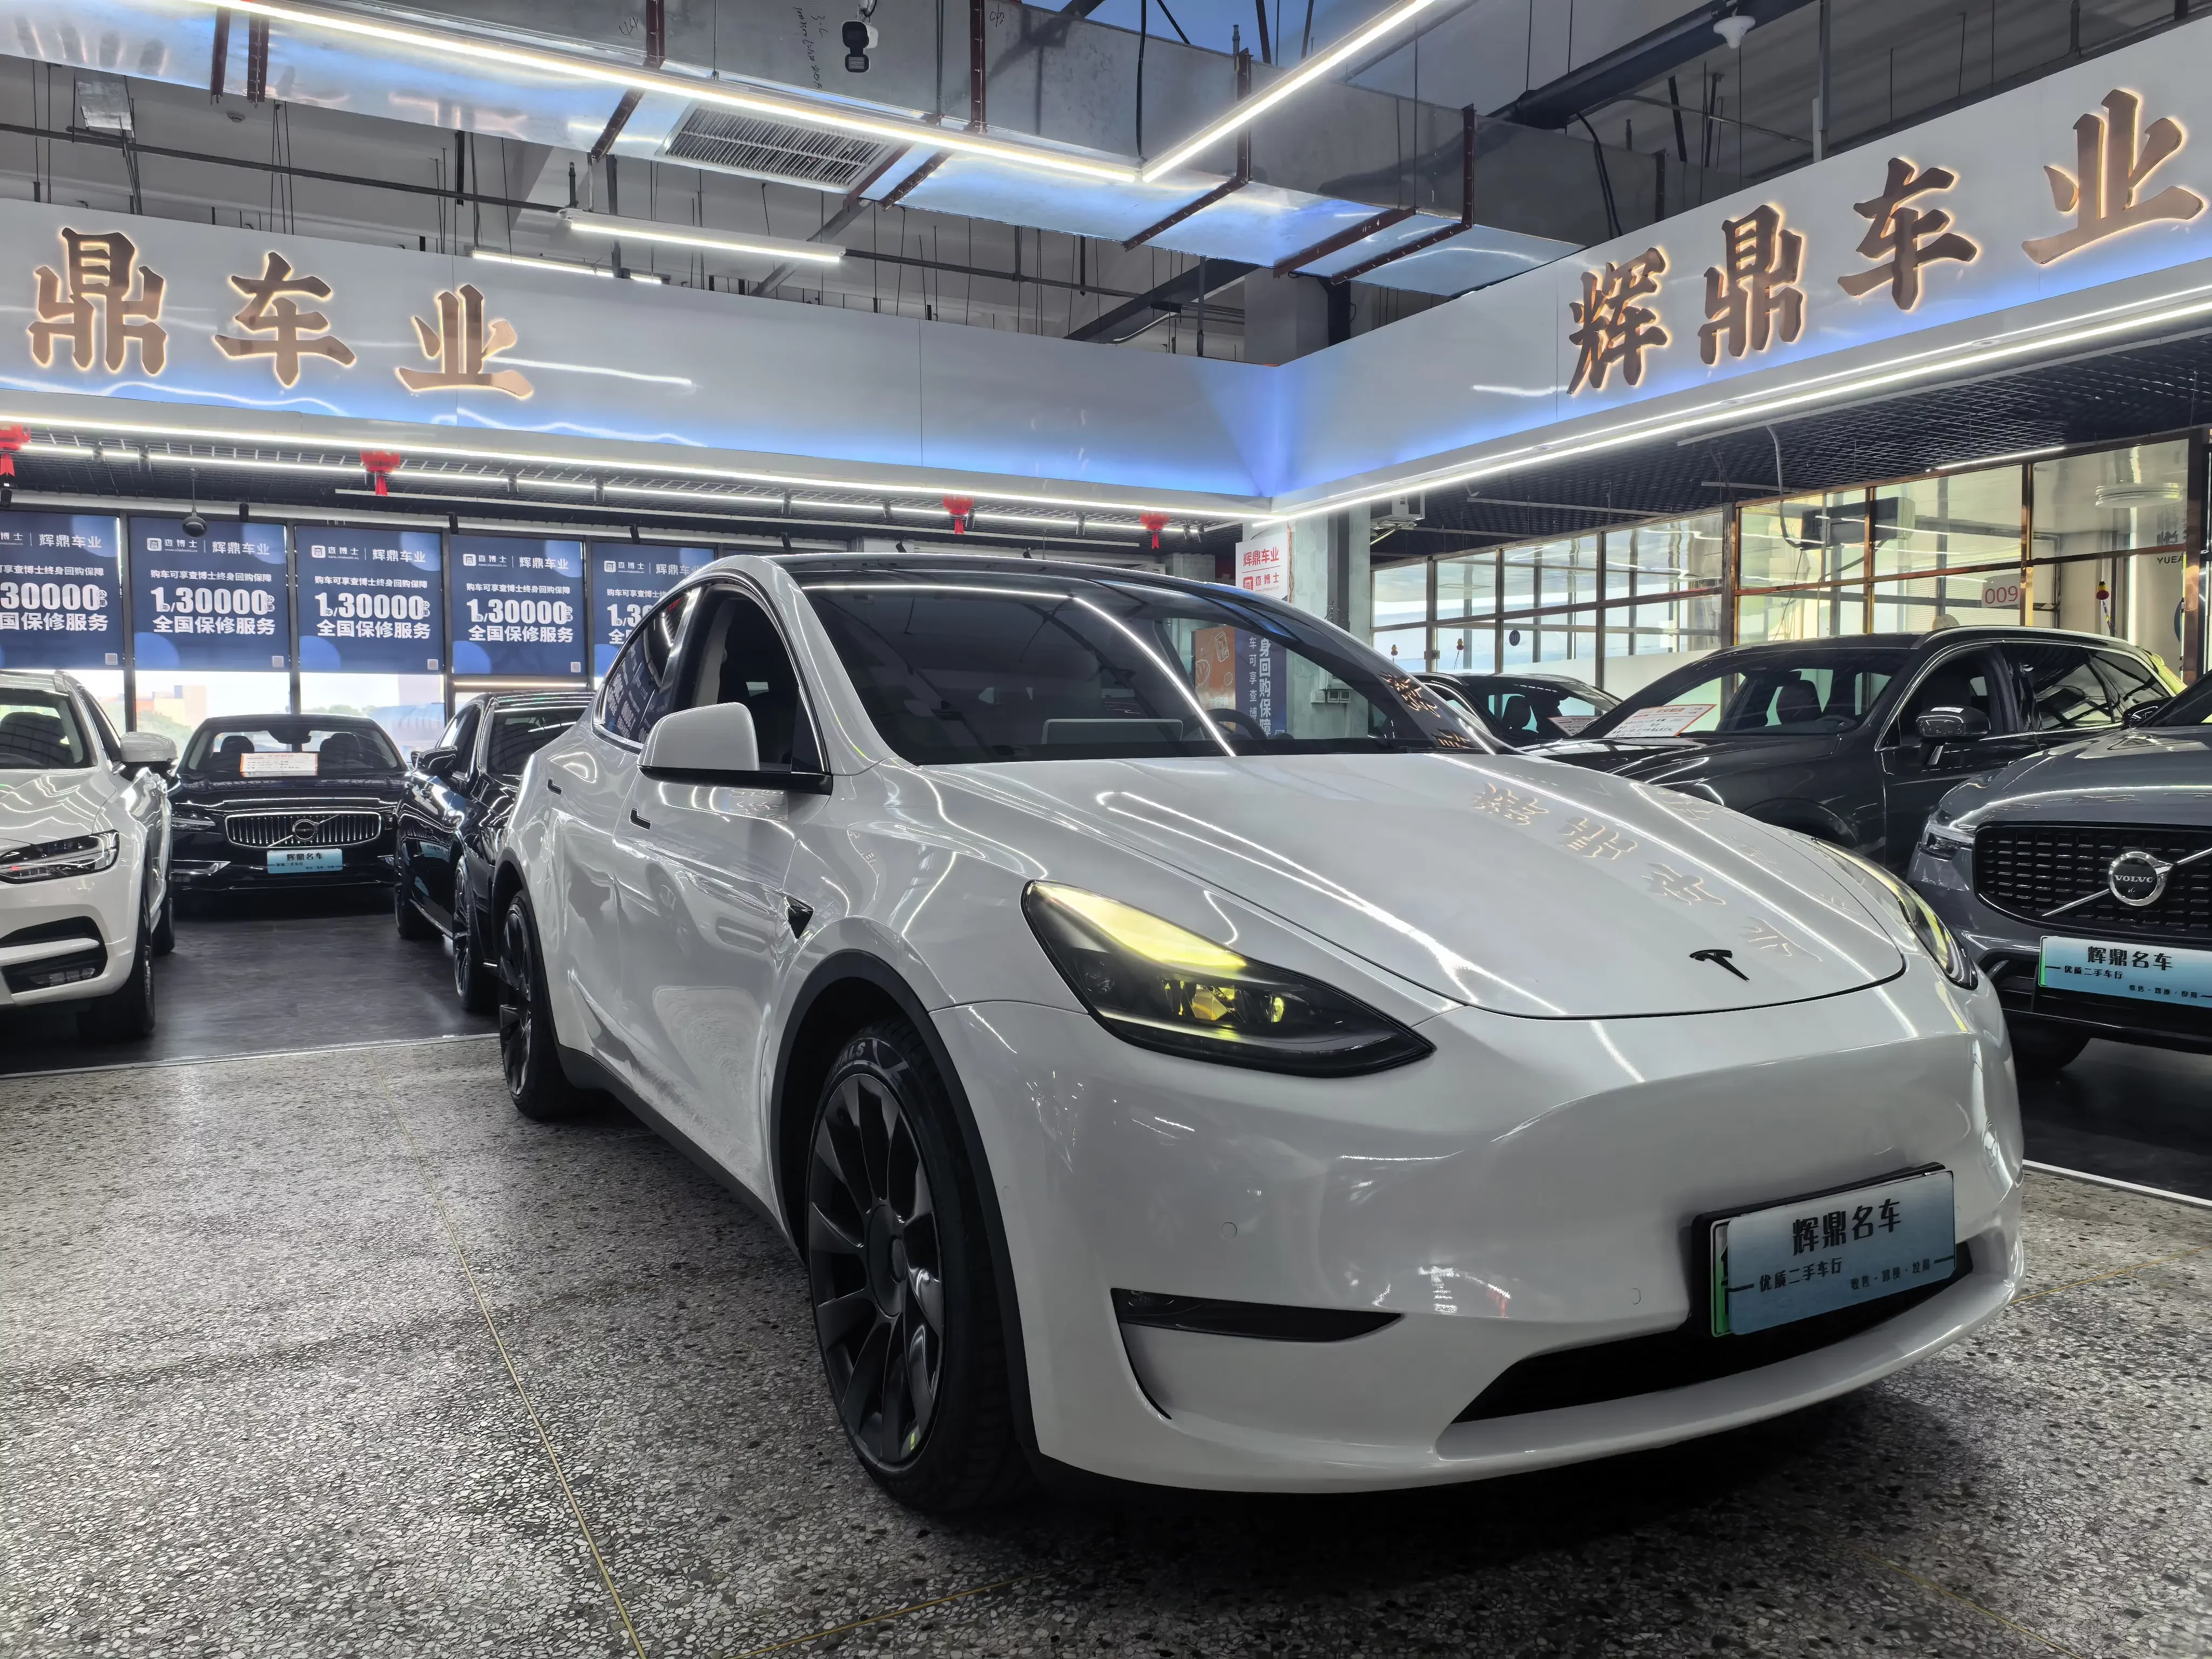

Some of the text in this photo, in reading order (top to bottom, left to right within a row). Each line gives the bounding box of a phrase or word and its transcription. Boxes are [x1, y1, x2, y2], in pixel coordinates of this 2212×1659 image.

[1566, 88, 2206, 395] 辉鼎车业
[28, 226, 535, 399] 鼎车业
[39, 534, 102, 548] 辉鼎车业
[164, 539, 198, 548] 查博士
[212, 541, 270, 555] 辉鼎车业
[328, 547, 359, 555] 查博士
[372, 549, 426, 562] 辉鼎车业
[1243, 546, 1279, 567] 辉鼎车业
[478, 555, 507, 563] 查博士
[519, 556, 569, 569] 辉鼎车业
[618, 562, 645, 570] 查博士
[150, 570, 272, 582] 购车可享查博士终身回购保障
[314, 576, 428, 588] 购车可享查博士终身回购保障
[1256, 572, 1279, 586] 查博士
[466, 583, 570, 594] 购车可享查博士终身回购保障
[1985, 585, 2018, 604] 009
[0, 612, 109, 631] 国保修服务
[152, 615, 275, 635] 全国保修服务
[316, 619, 431, 639] 全国保修服务
[468, 624, 574, 643] 全国保修服务
[1259, 638, 1271, 737] 身回购保障
[2114, 875, 2153, 883] VOLVO
[2087, 946, 2173, 971] 辉鼎名车
[1792, 1198, 1901, 1256] 辉鼎名车
[1759, 1257, 1842, 1292] 优质二手车行
